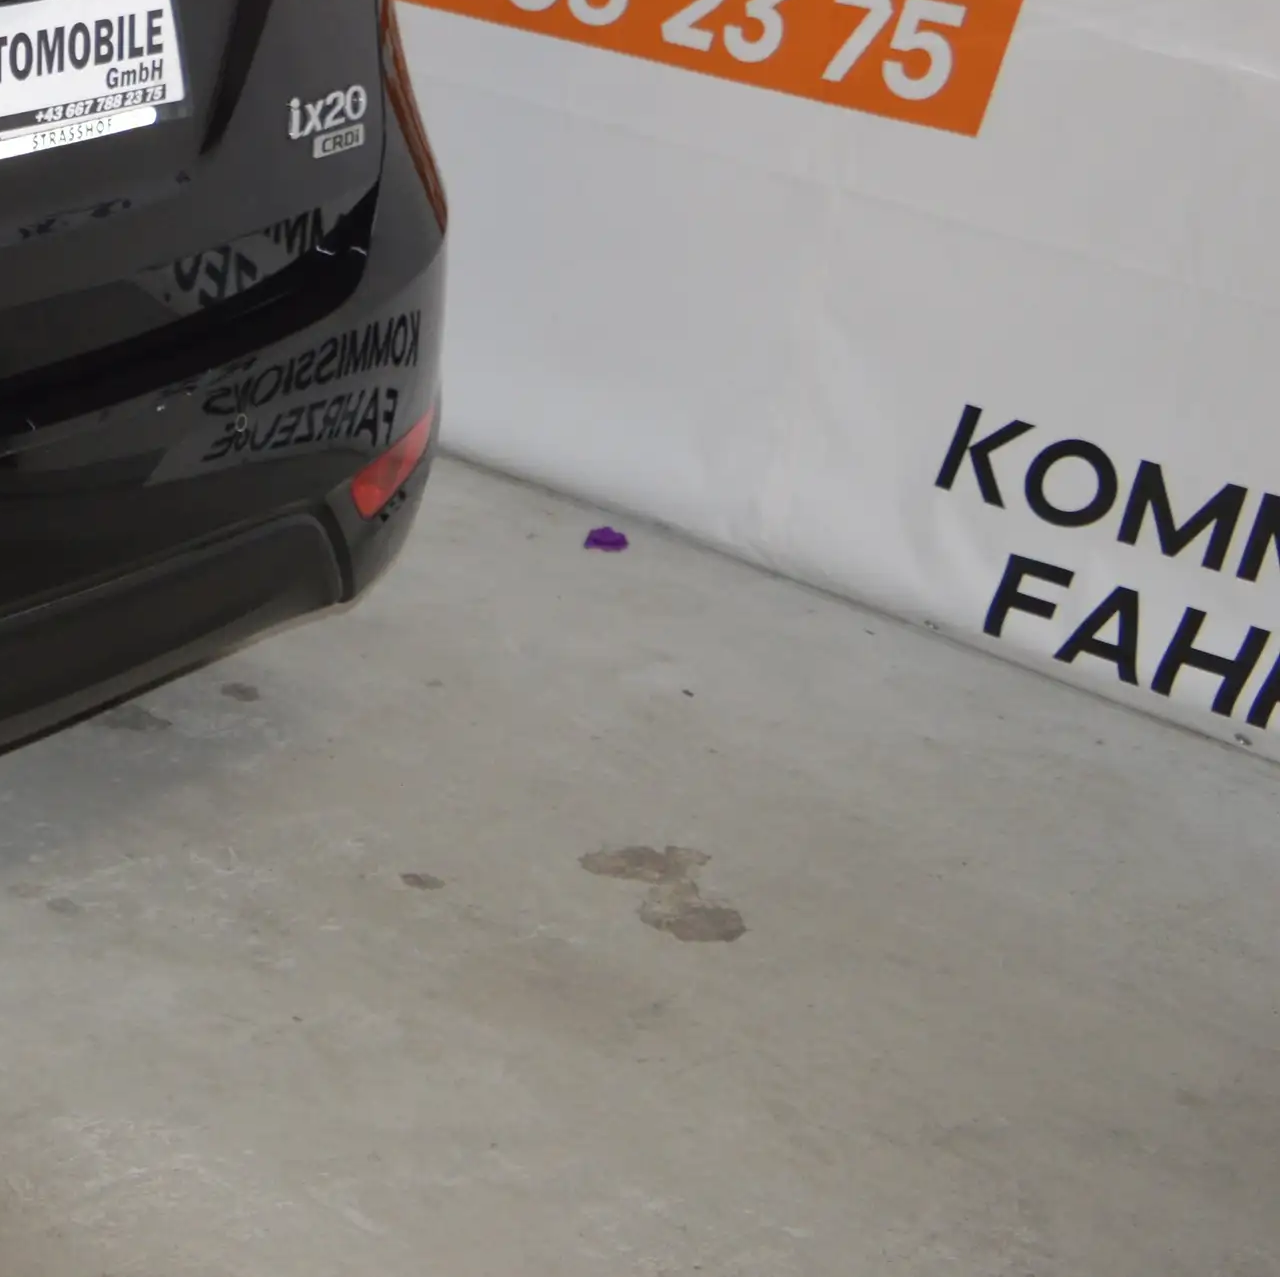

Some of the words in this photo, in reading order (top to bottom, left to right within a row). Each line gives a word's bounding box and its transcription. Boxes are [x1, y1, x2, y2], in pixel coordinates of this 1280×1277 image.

[105, 58, 164, 89] GmbH
[35, 101, 62, 123] +43
[65, 97, 93, 118] 667
[96, 92, 122, 112] 788
[123, 88, 143, 107] 23
[145, 84, 164, 101] 75
[288, 85, 368, 140] ix20
[32, 118, 113, 149] STRASSHOF
[321, 128, 360, 154] CRDi
